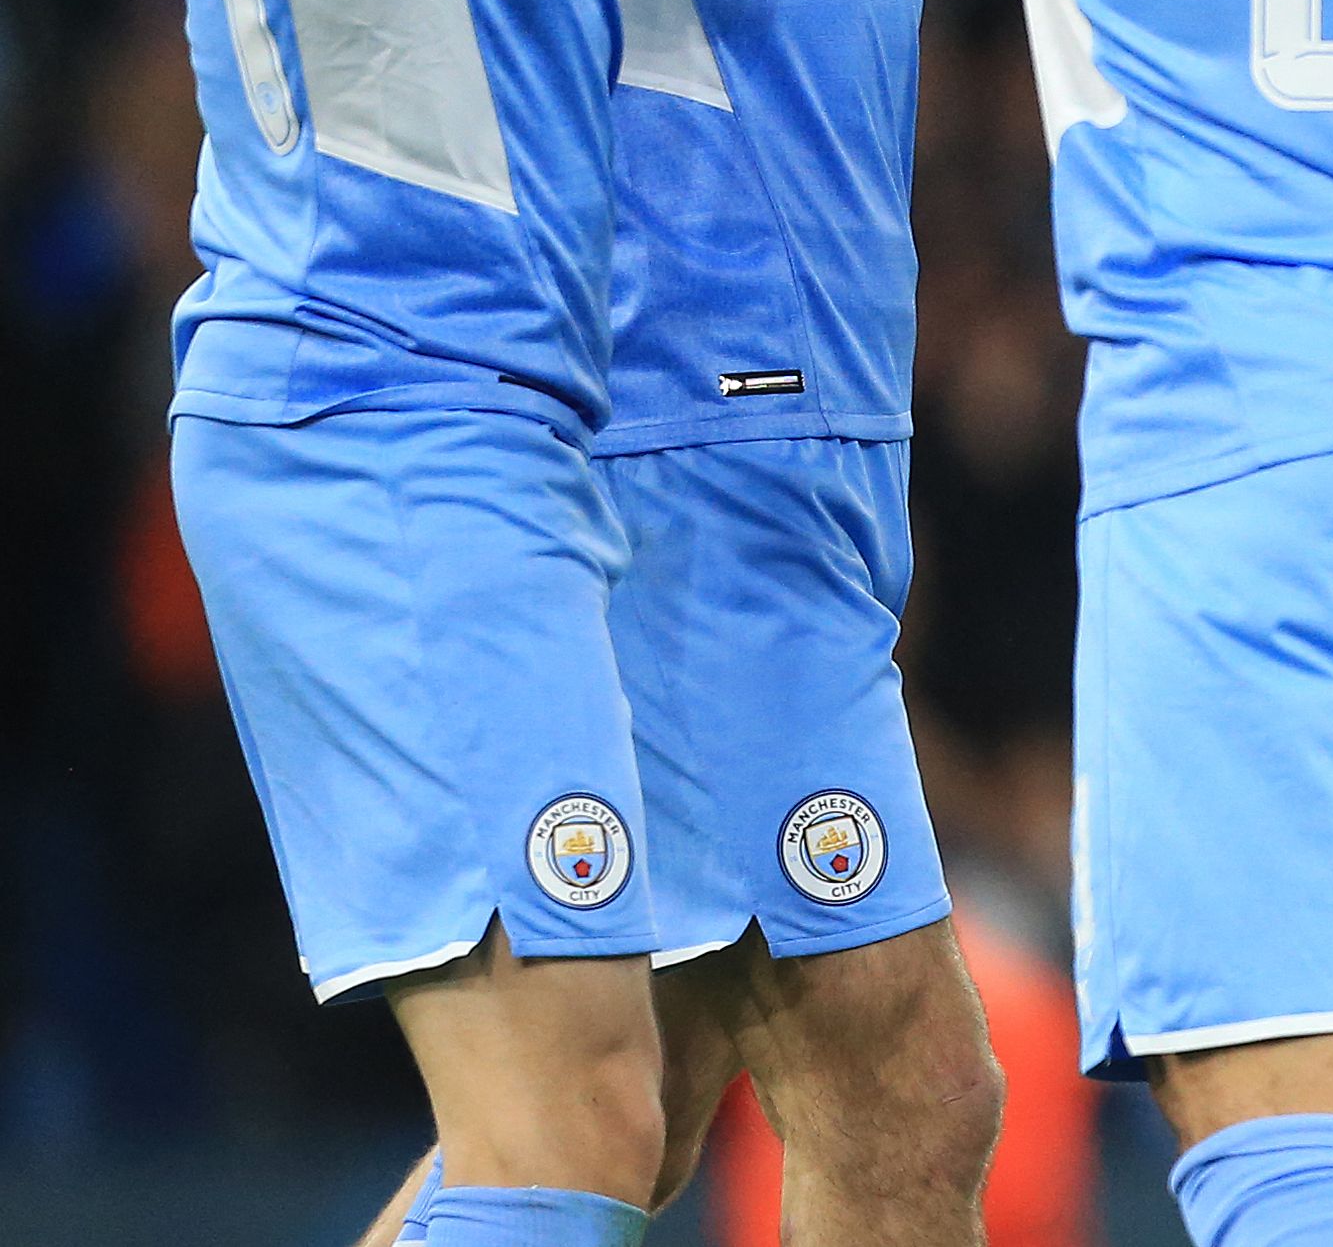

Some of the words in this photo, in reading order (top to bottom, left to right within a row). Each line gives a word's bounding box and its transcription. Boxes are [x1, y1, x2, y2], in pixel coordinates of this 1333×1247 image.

[536, 802, 620, 840] MANCHESTER
[787, 798, 871, 844] MANCHESTER
[569, 889, 601, 902] CITY
[831, 880, 862, 898] CITY
